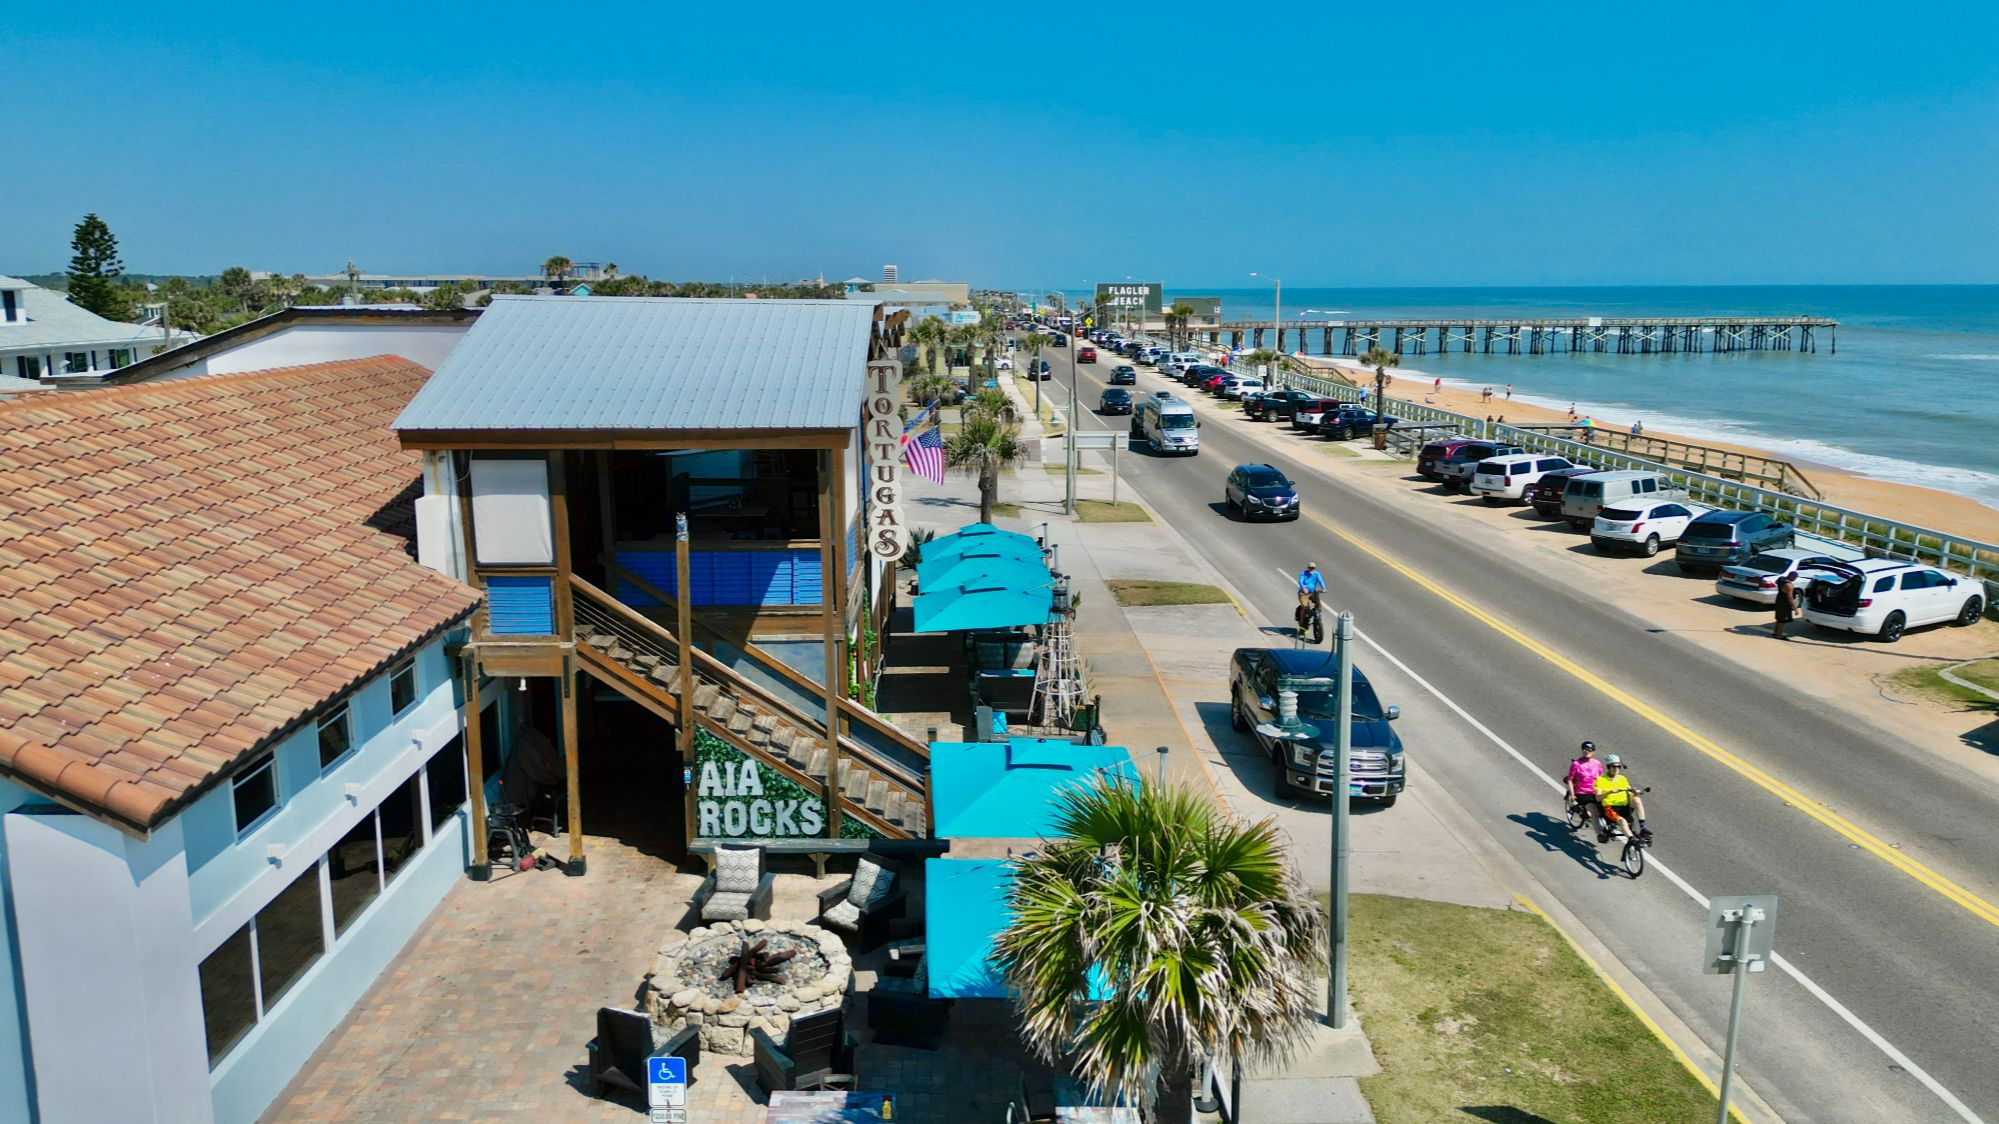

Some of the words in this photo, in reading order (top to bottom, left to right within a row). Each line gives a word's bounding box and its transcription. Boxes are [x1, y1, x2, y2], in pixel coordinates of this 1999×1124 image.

[1108, 286, 1150, 295] FLAGLER
[867, 365, 901, 558] TORTUGAS
[699, 798, 822, 836] ROCKS
